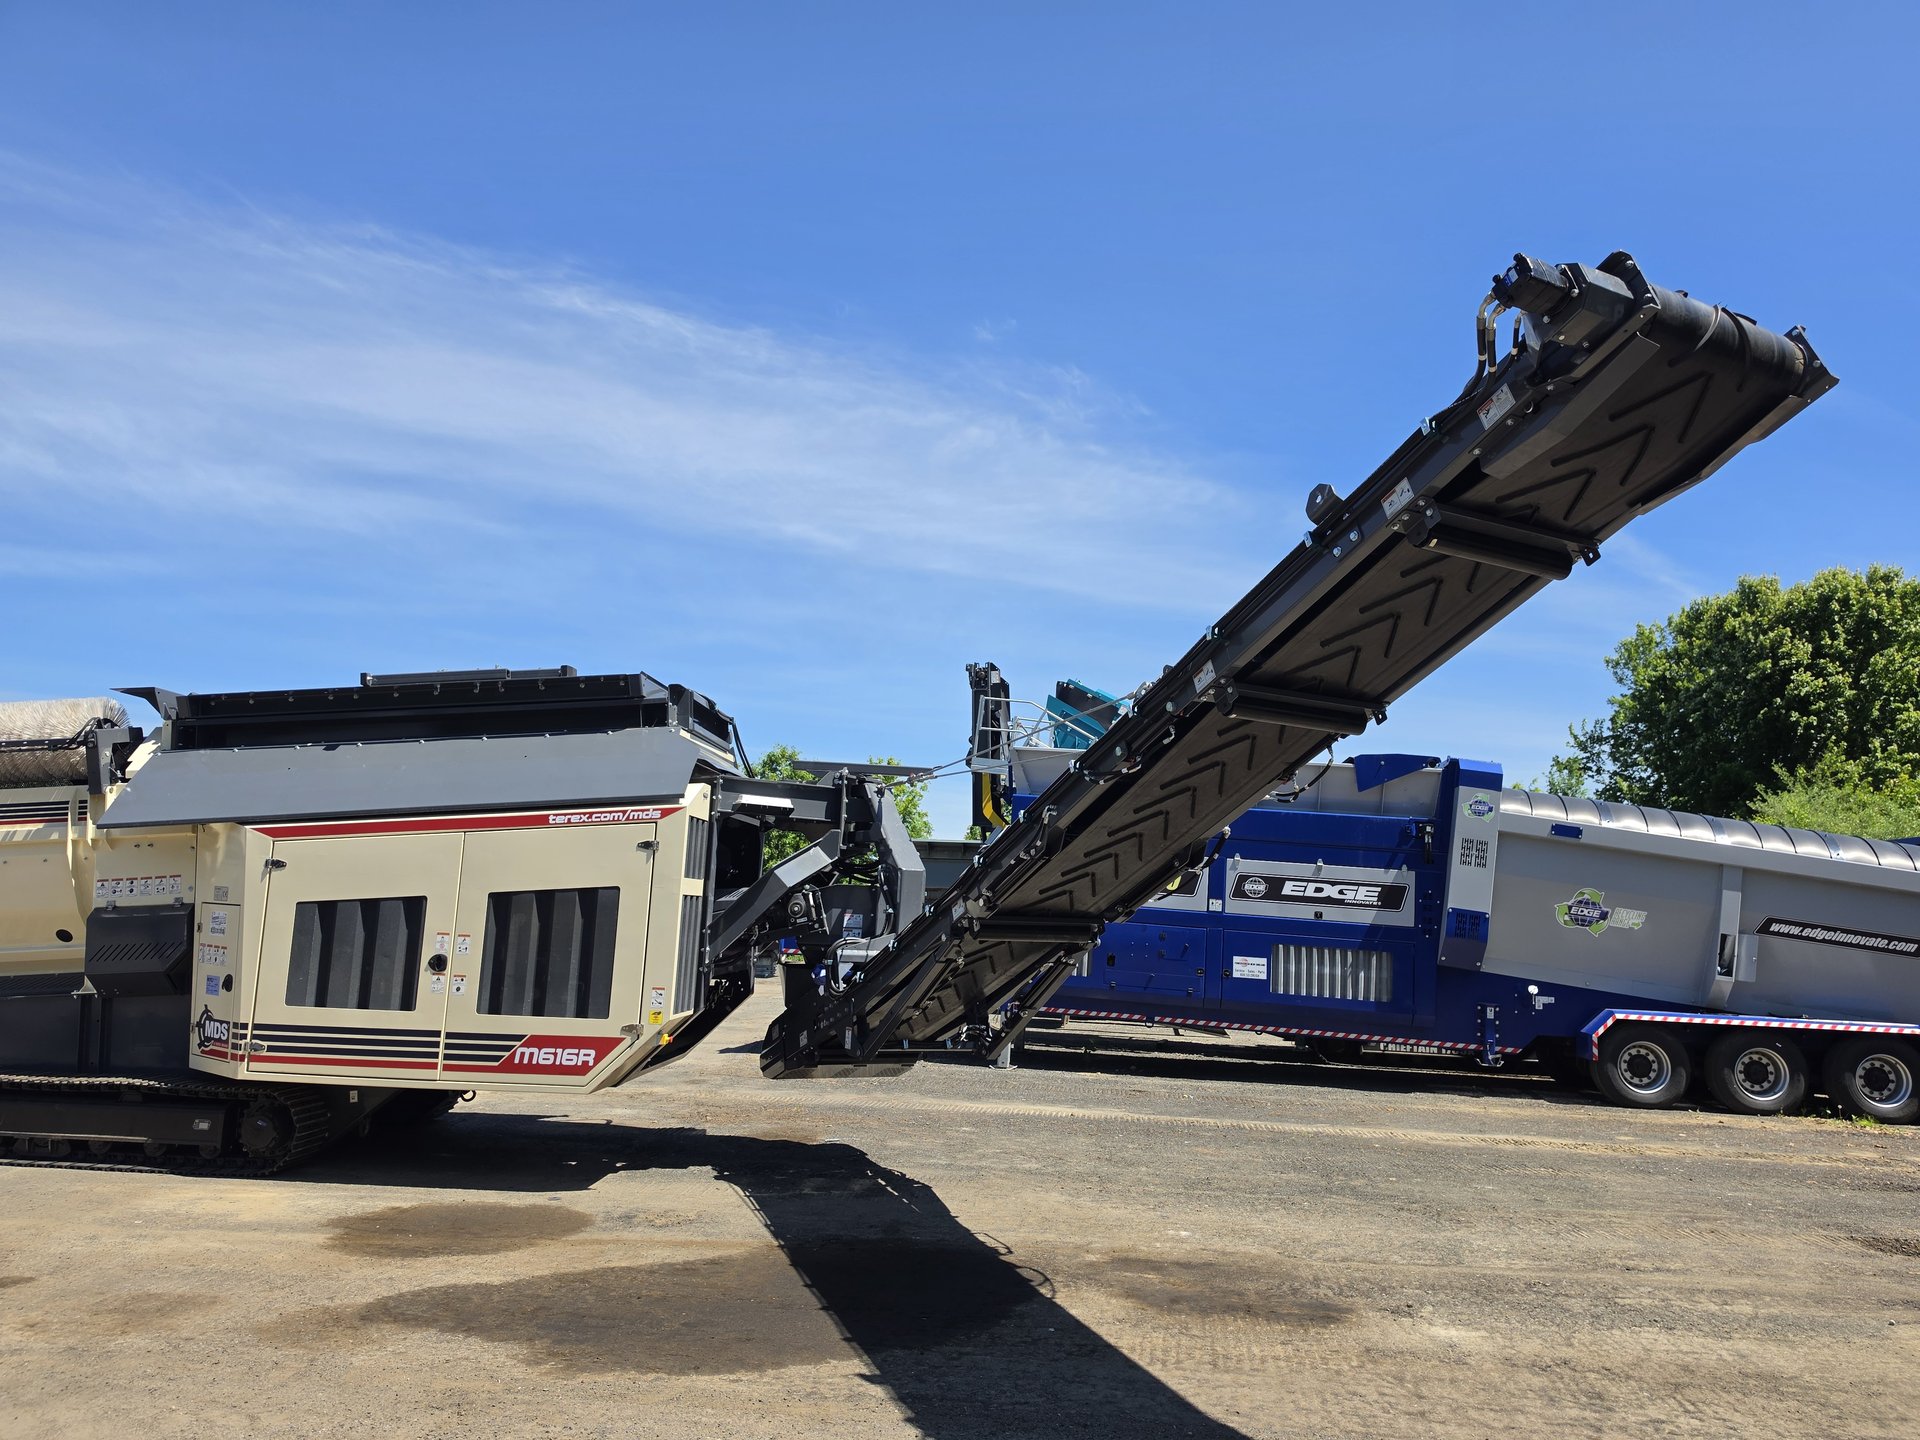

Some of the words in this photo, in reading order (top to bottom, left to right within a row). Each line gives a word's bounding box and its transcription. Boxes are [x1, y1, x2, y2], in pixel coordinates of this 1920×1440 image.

[548, 808, 662, 824] terex.com/mds
[1281, 880, 1382, 901] EDGE
[1570, 906, 1602, 918] EDGE
[1769, 922, 1919, 953] www.edgeinnovate.com
[205, 1020, 229, 1040] MDS
[513, 1046, 596, 1067] M616R
